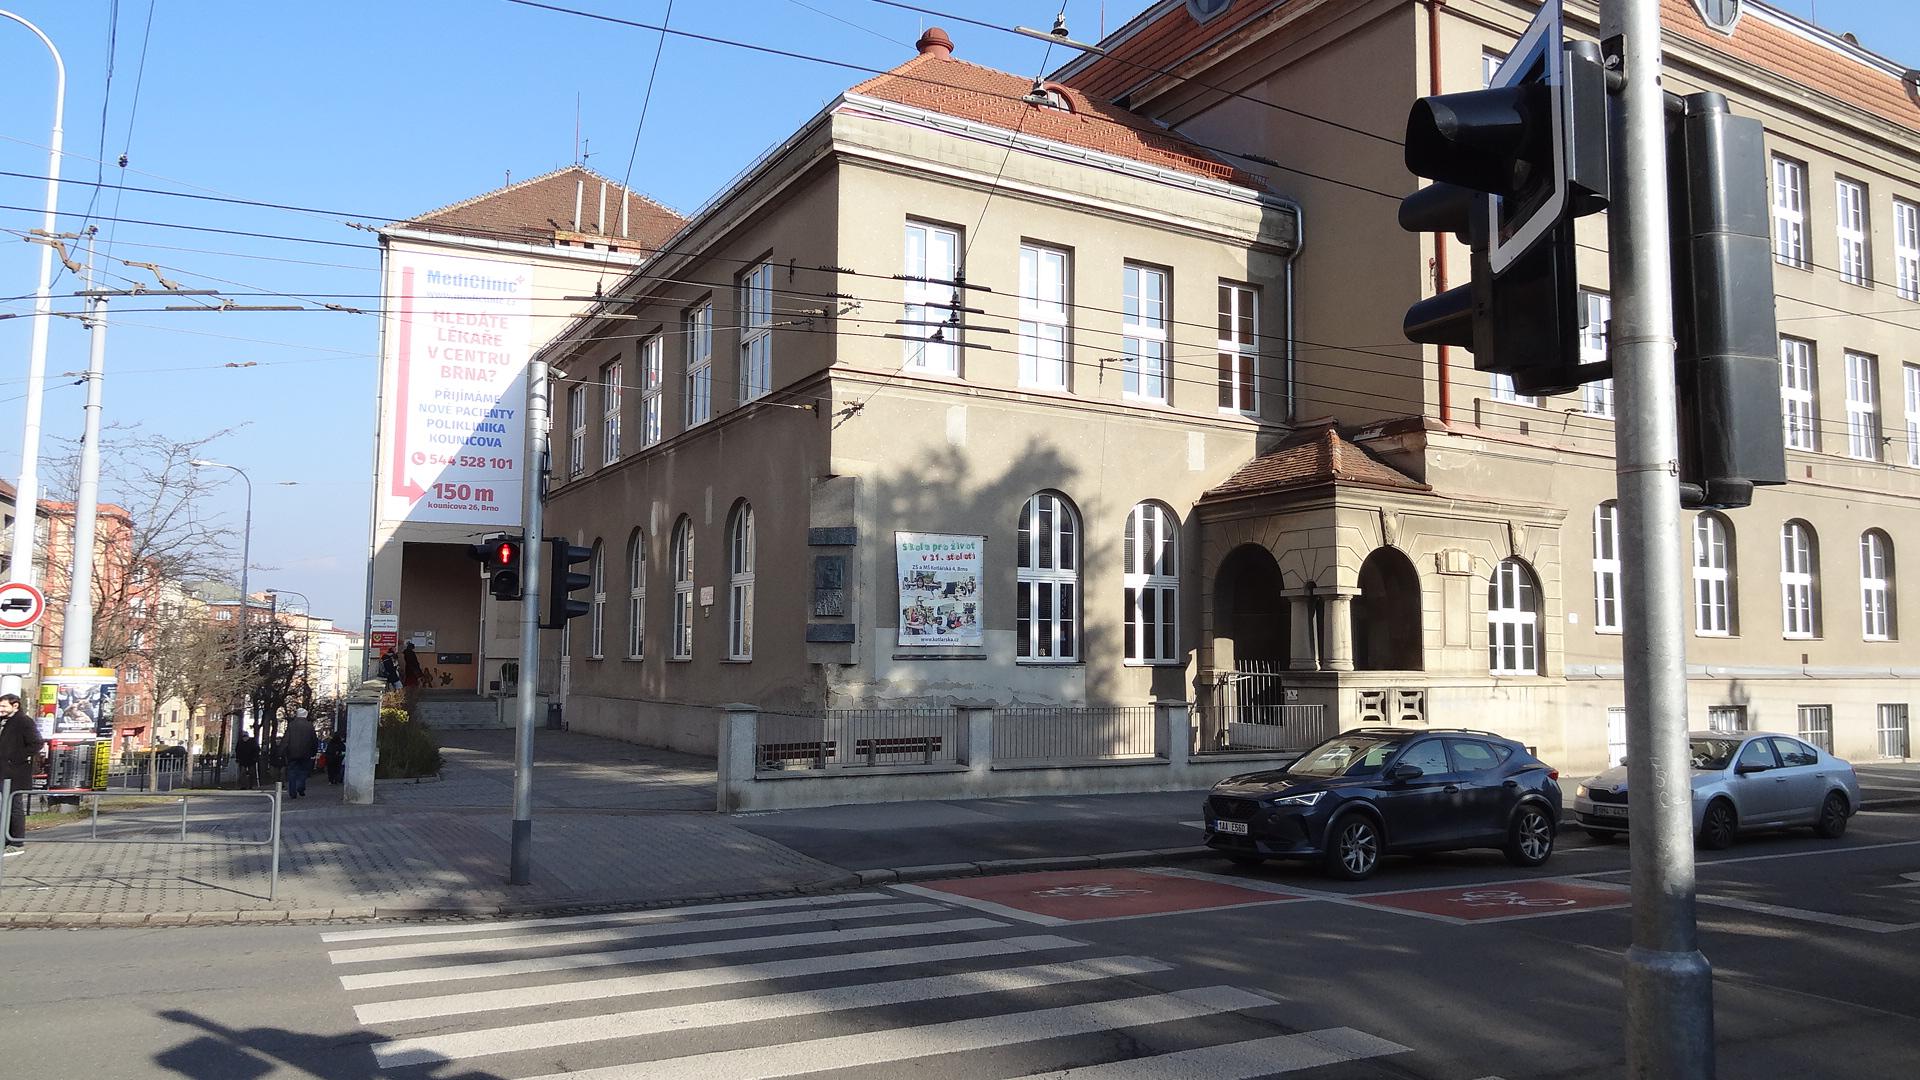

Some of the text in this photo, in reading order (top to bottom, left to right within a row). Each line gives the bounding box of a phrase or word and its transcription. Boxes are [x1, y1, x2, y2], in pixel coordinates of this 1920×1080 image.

[433, 311, 508, 329] HLEDÁTE
[438, 326, 503, 347] LÉKAŘE
[428, 346, 510, 366] V CENTRU
[440, 365, 496, 383] BRNA?
[435, 388, 500, 404] PŘIJÍMÁME
[419, 402, 514, 419] NOVÉ PACIENTY
[427, 418, 506, 433] POLIKLINIKA
[429, 433, 502, 447] KOUNICOVA
[430, 454, 512, 469] 544 528 101
[432, 482, 493, 501] 150 m
[932, 543, 949, 552] pro
